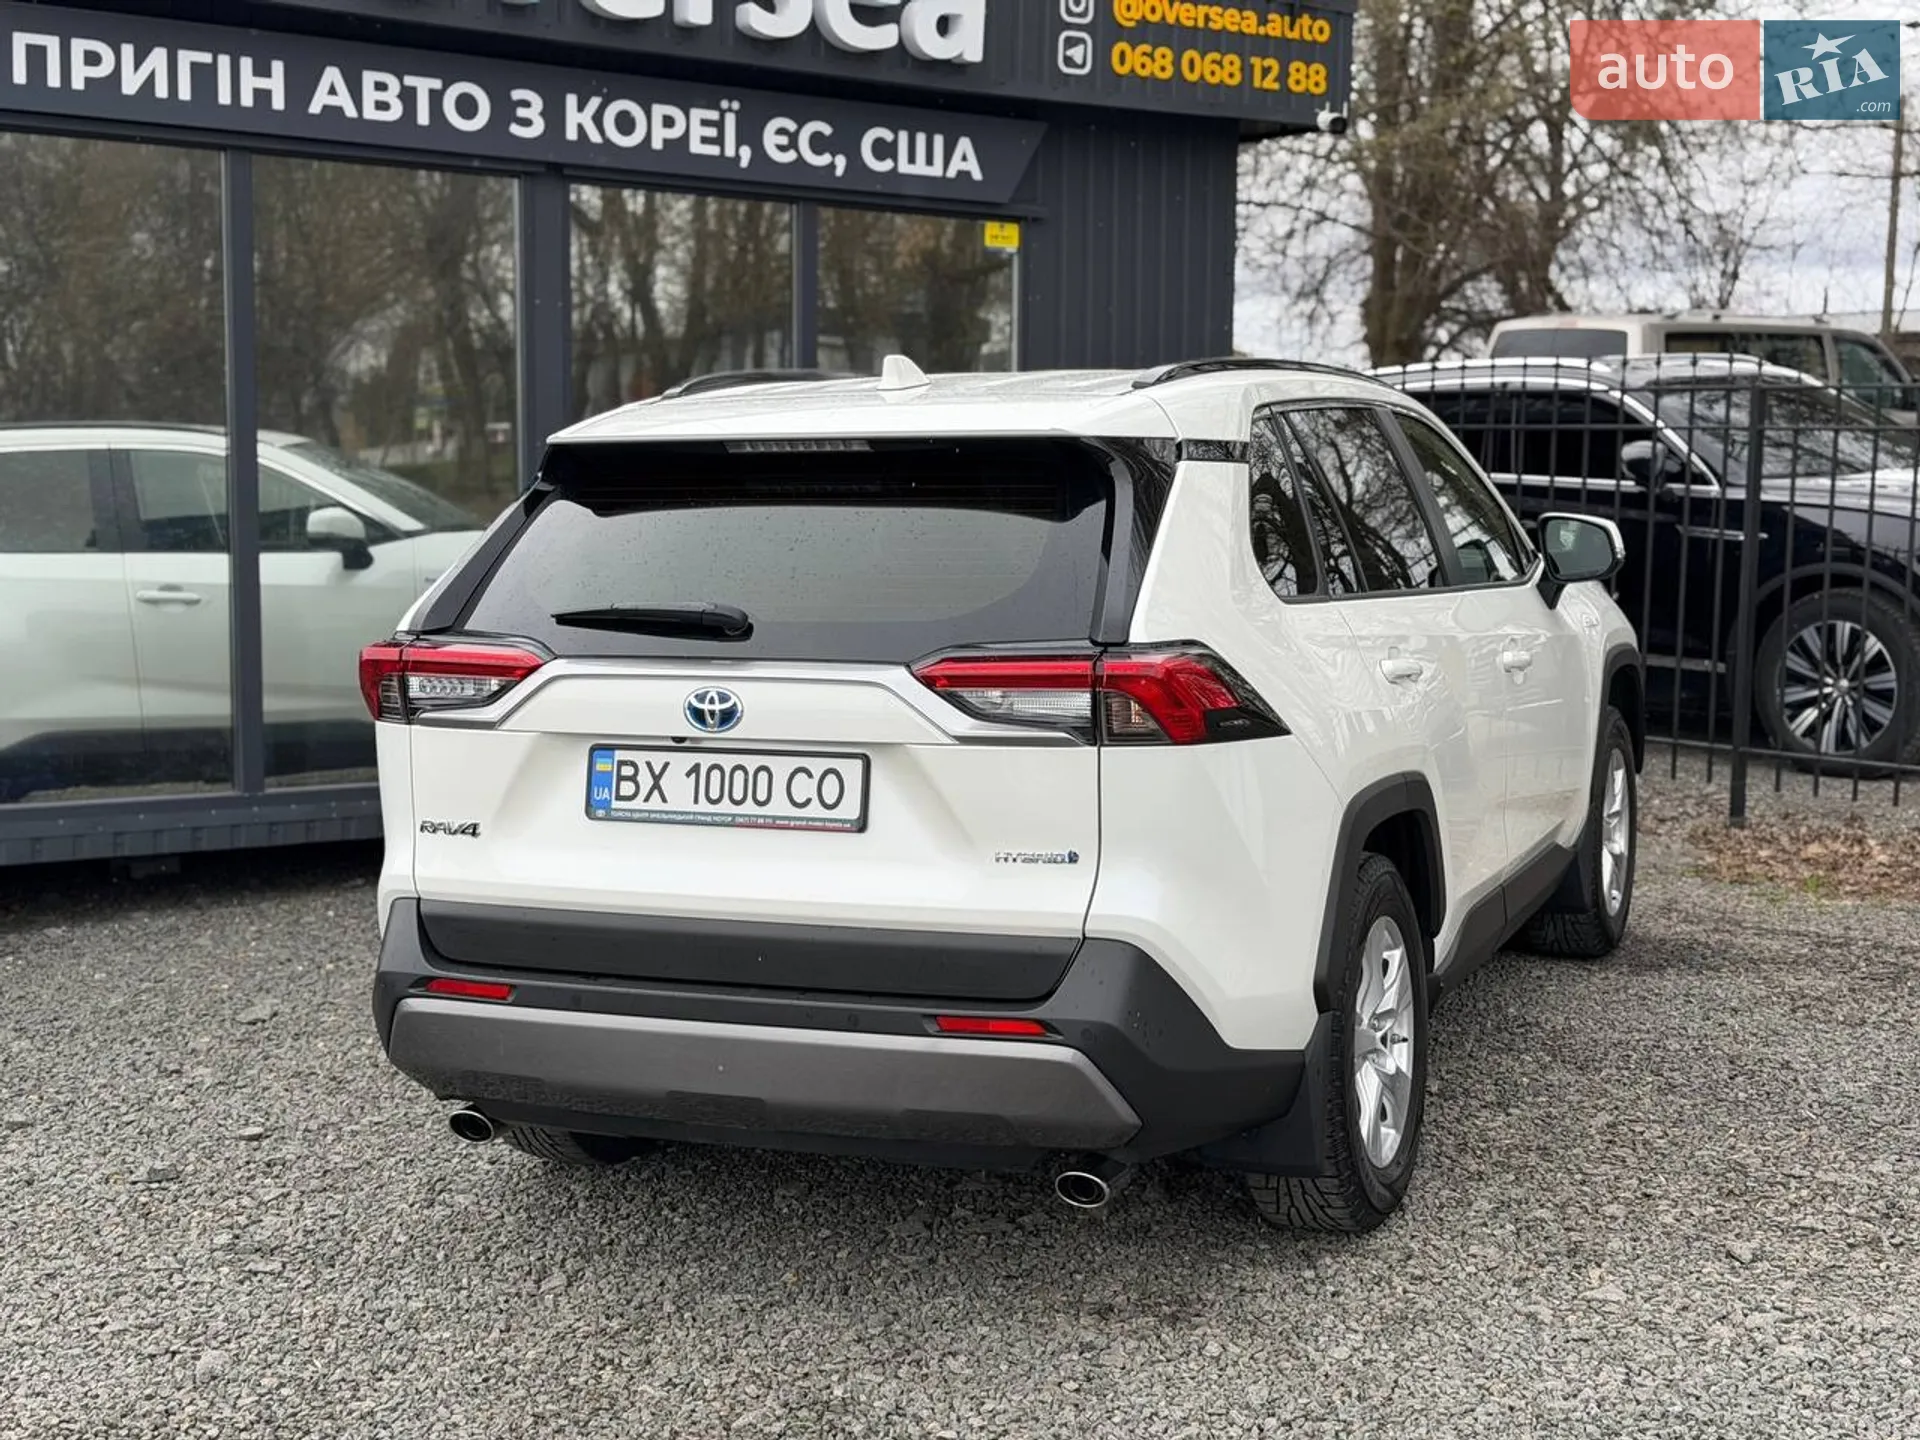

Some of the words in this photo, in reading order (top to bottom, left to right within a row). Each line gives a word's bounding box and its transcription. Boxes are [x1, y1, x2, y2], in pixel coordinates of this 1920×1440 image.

[1113, 0, 1331, 42] @oversea.auto
[1111, 41, 1174, 80] 068
[1181, 49, 1242, 86] 068
[1250, 56, 1280, 90] 12
[1287, 60, 1327, 95] 88
[12, 31, 284, 111] ПРИГІН
[307, 65, 491, 132] АВТО
[565, 93, 751, 168] КОРЕЇ,
[762, 117, 847, 177] ЄС,
[860, 126, 983, 181] США
[594, 787, 610, 800] UA
[614, 759, 670, 804] BX
[685, 762, 774, 807] 1000
[786, 766, 845, 811] CO
[420, 820, 481, 838] RAV4
